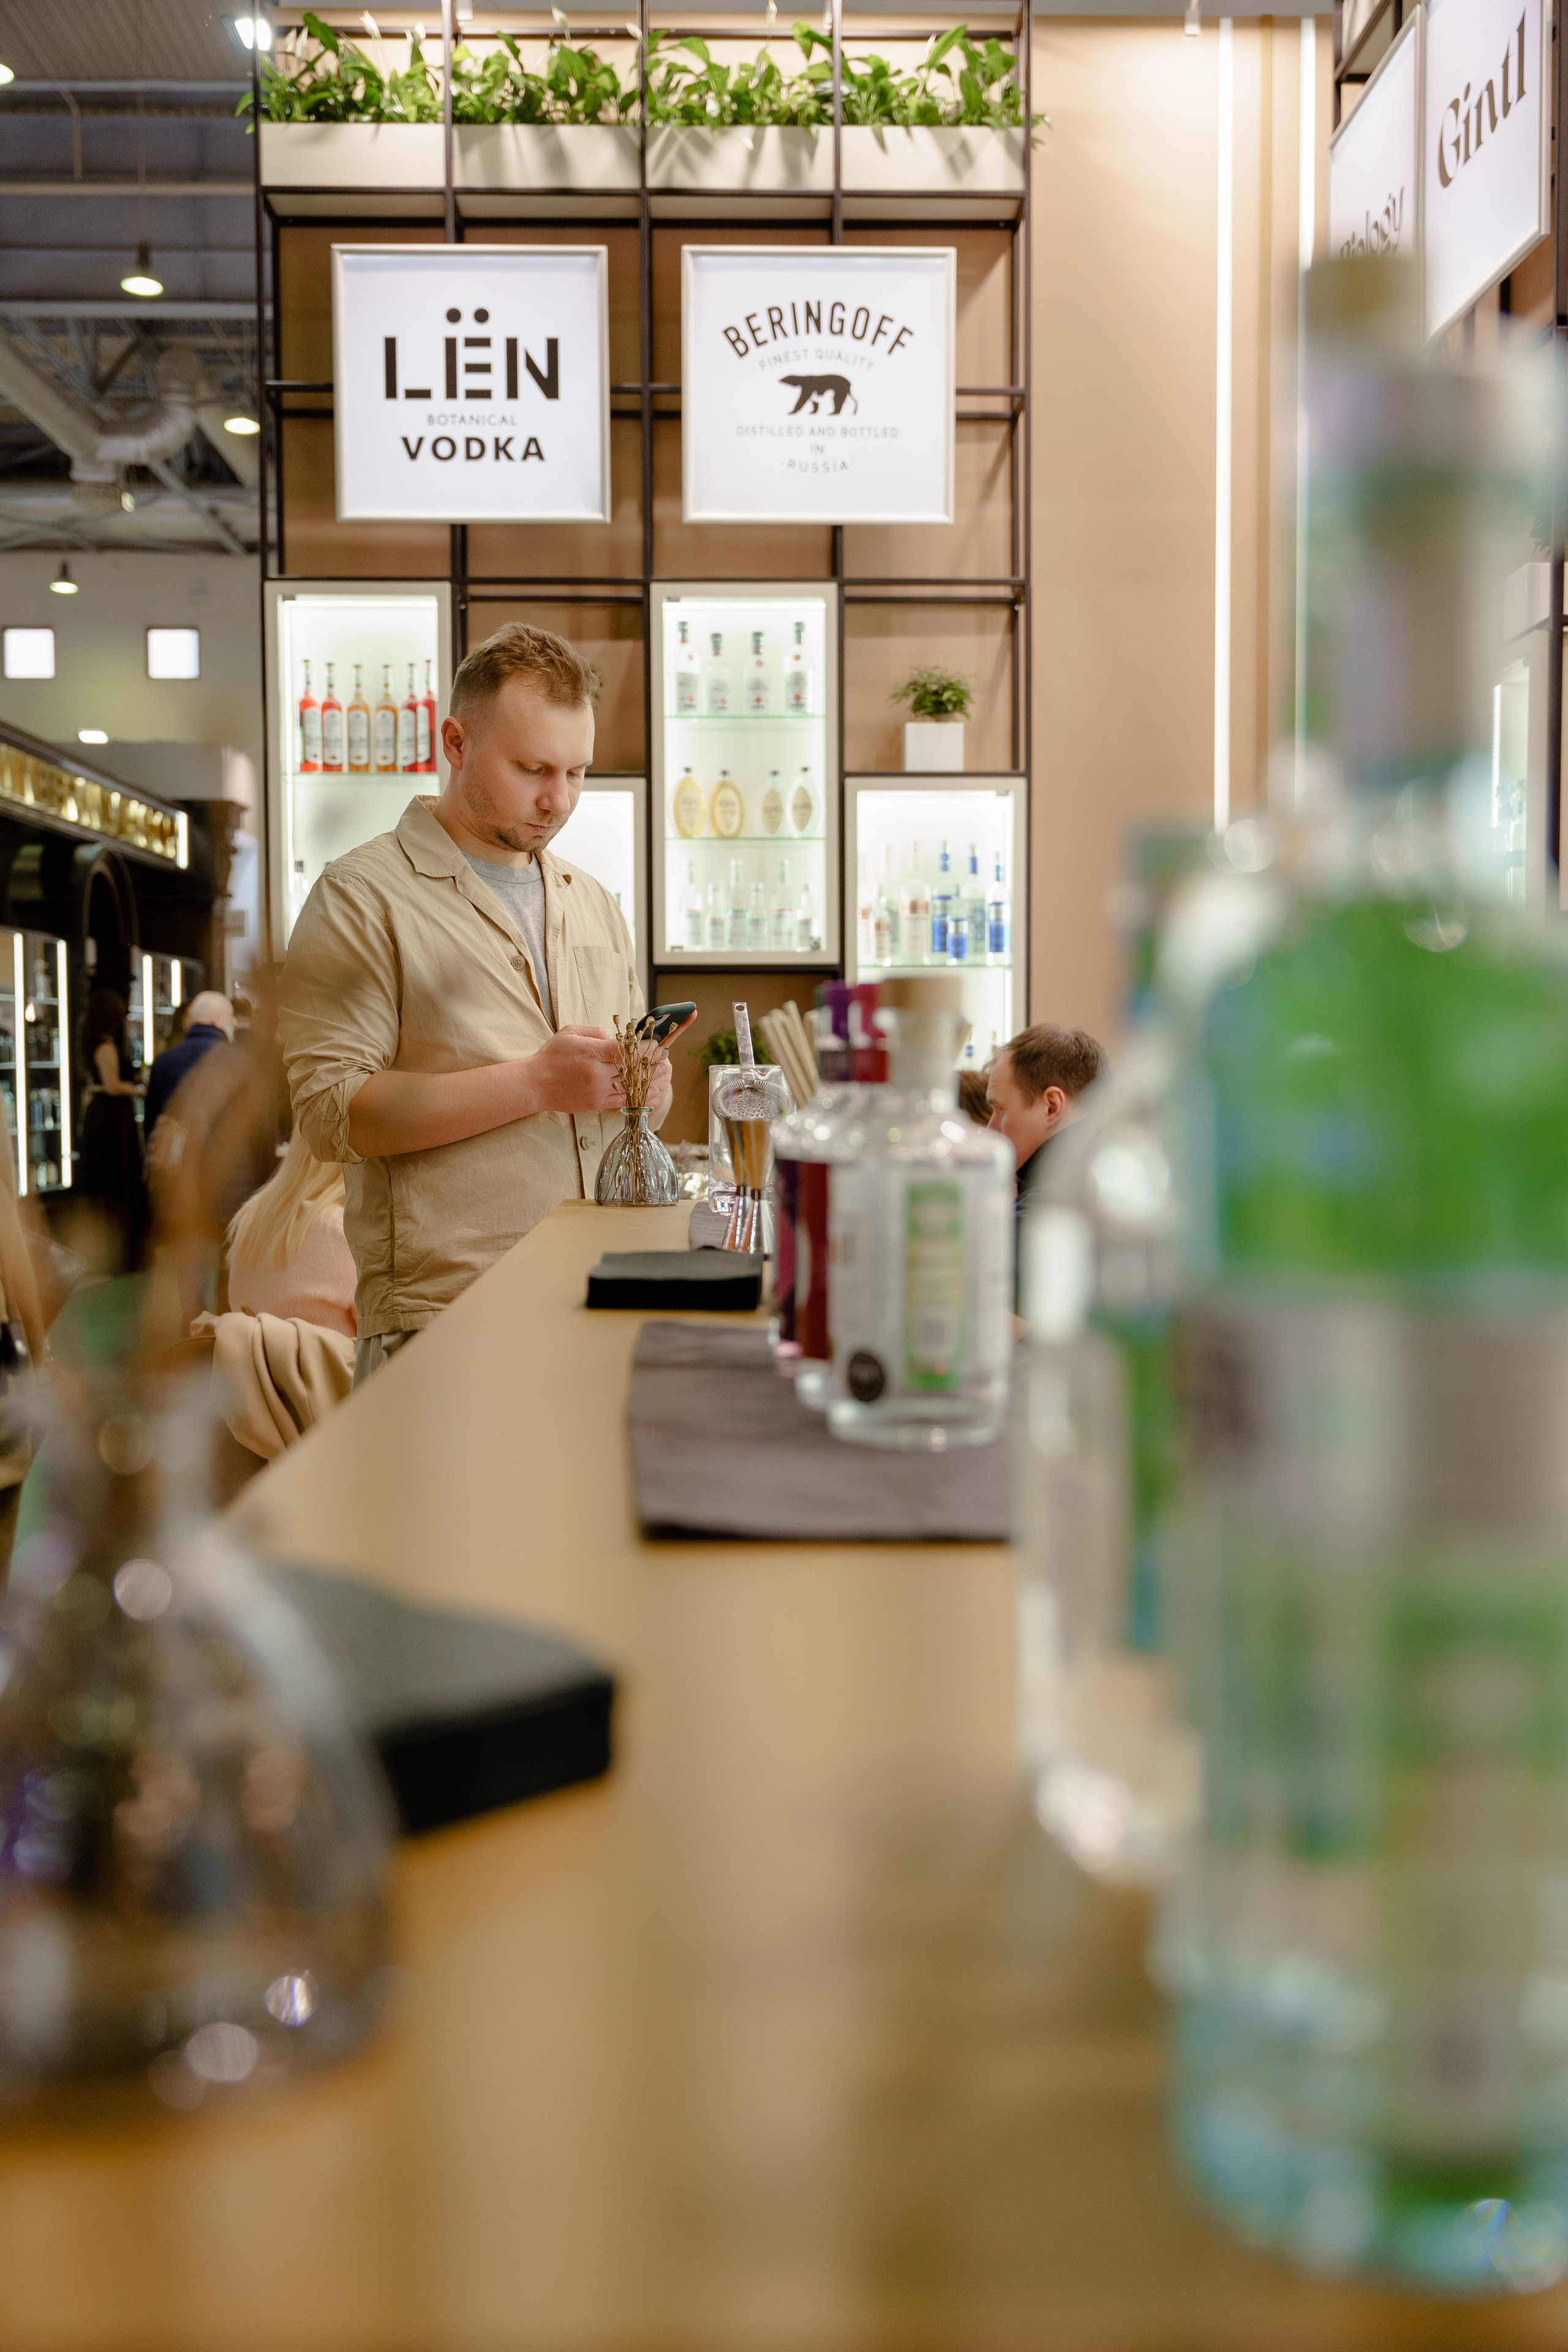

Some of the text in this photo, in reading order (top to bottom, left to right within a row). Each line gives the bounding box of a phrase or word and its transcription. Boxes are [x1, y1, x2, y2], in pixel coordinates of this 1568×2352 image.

[1438, 6, 1527, 189] Gintl
[722, 300, 914, 358] BERINGOFF
[758, 349, 875, 371] FINEST QUALITY
[426, 413, 518, 426] BOTANICAL
[736, 425, 900, 439] DISTILLED AND BOTTLED
[401, 436, 545, 461] VODKA
[810, 444, 825, 454] IN
[786, 459, 850, 473] RUSSIA
